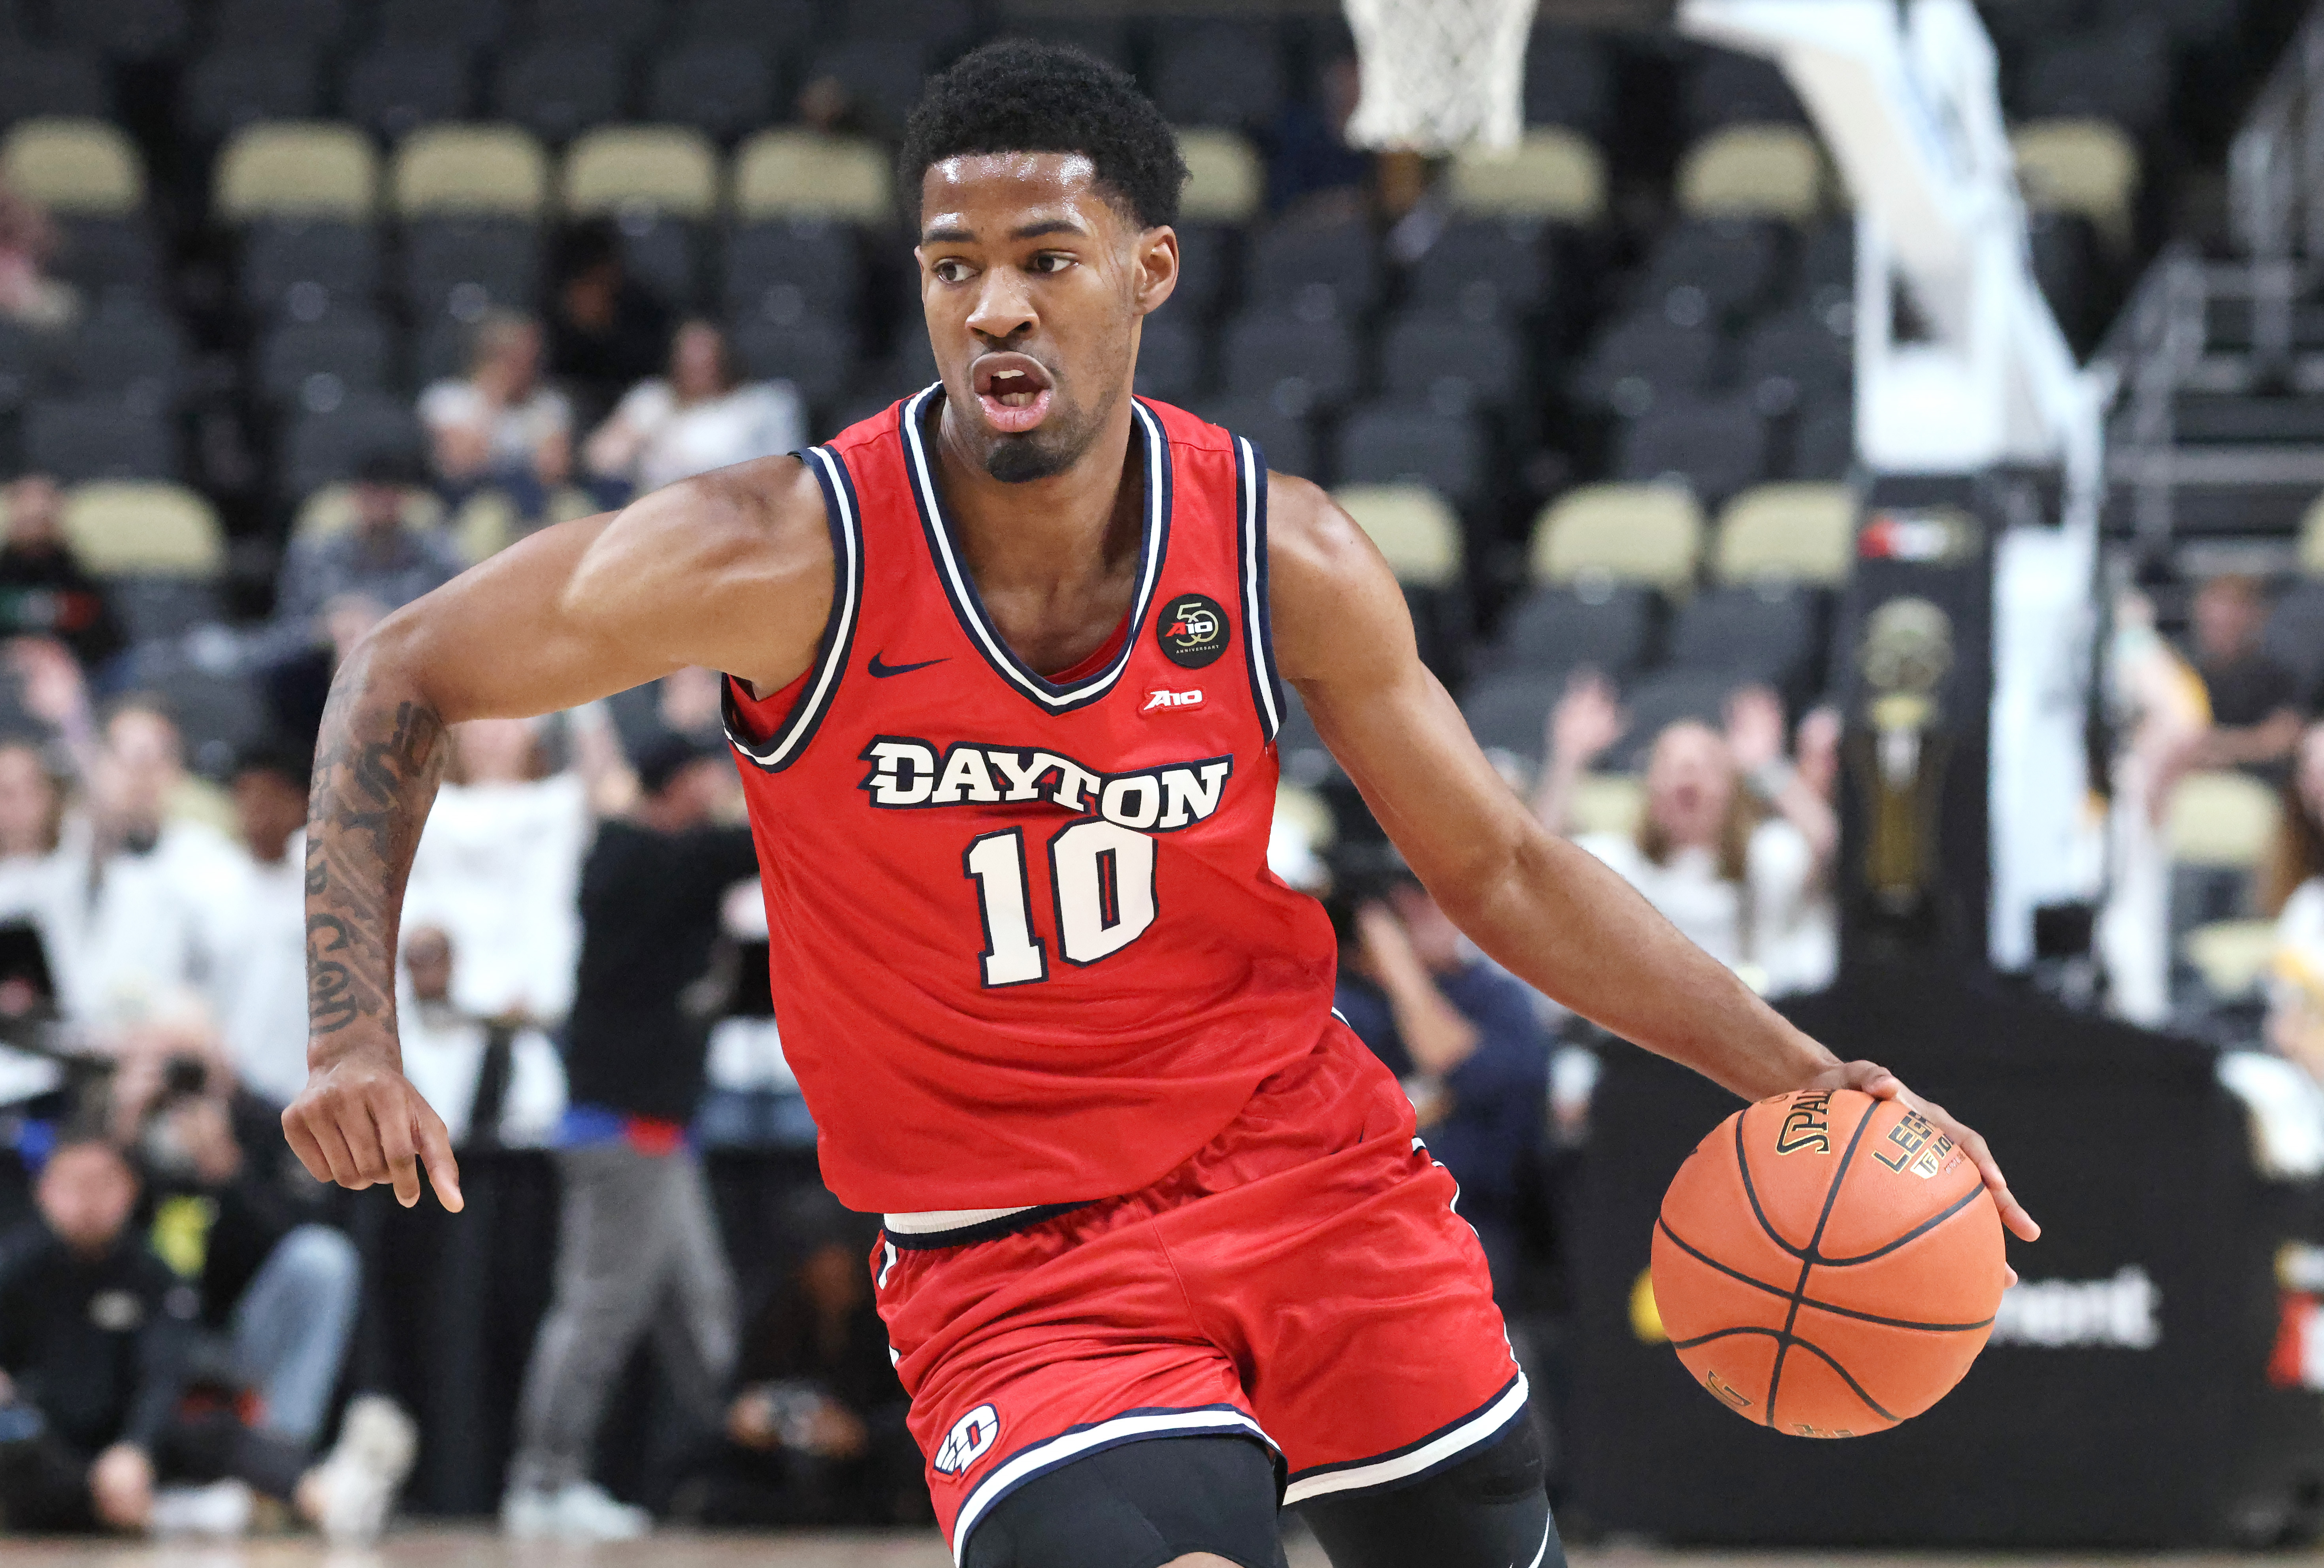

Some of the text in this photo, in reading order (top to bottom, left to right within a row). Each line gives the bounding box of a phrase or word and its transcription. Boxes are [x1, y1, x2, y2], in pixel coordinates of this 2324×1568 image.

[1165, 621, 1213, 637] A10
[1176, 644, 1220, 654] ANNIVERSARY
[1143, 690, 1203, 710] A10
[858, 734, 1233, 833] DAYTON
[963, 816, 1159, 988] 10
